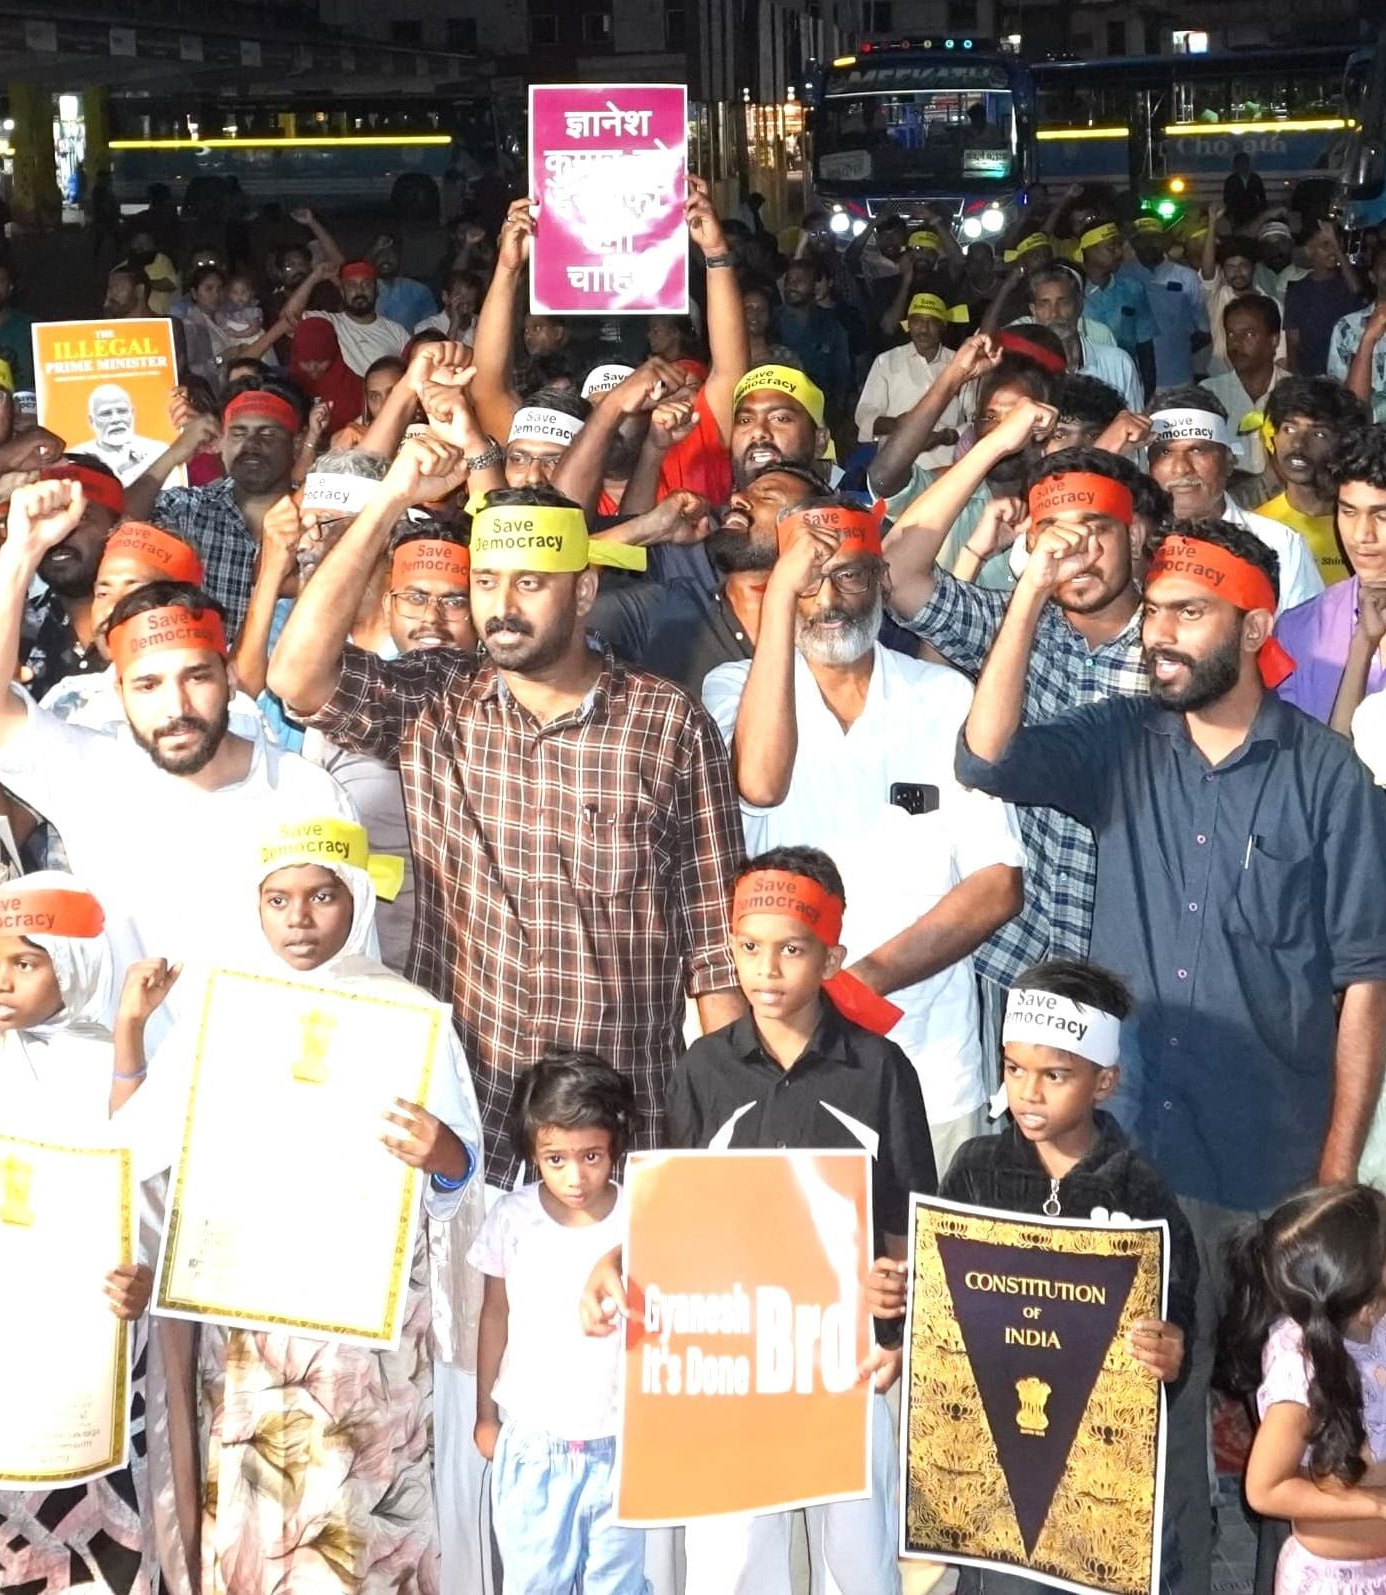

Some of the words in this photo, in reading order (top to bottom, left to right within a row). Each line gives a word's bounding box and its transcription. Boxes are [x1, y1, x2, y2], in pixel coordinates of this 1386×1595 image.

[565, 101, 653, 138] ज्ञानेश
[53, 338, 159, 360] ILLEGAL
[97, 356, 167, 371] MINISTER
[526, 411, 557, 424] Save
[1163, 417, 1193, 429] Save
[1158, 427, 1213, 442] emocracy
[305, 486, 350, 504] ocracy
[1036, 491, 1095, 511] mocracy
[493, 518, 533, 534] Save
[803, 512, 840, 526] Save
[117, 536, 173, 563] mocracy
[417, 544, 452, 557] Save
[148, 612, 189, 630] Save
[753, 878, 797, 894] Save
[1017, 988, 1058, 1010] Save
[1006, 1010, 1088, 1042] emocracy
[965, 1271, 1107, 1305] CONSTITUTION
[1022, 1306, 1043, 1319] OF
[1004, 1326, 1062, 1350] INDIA
[686, 1346, 751, 1396] Done
